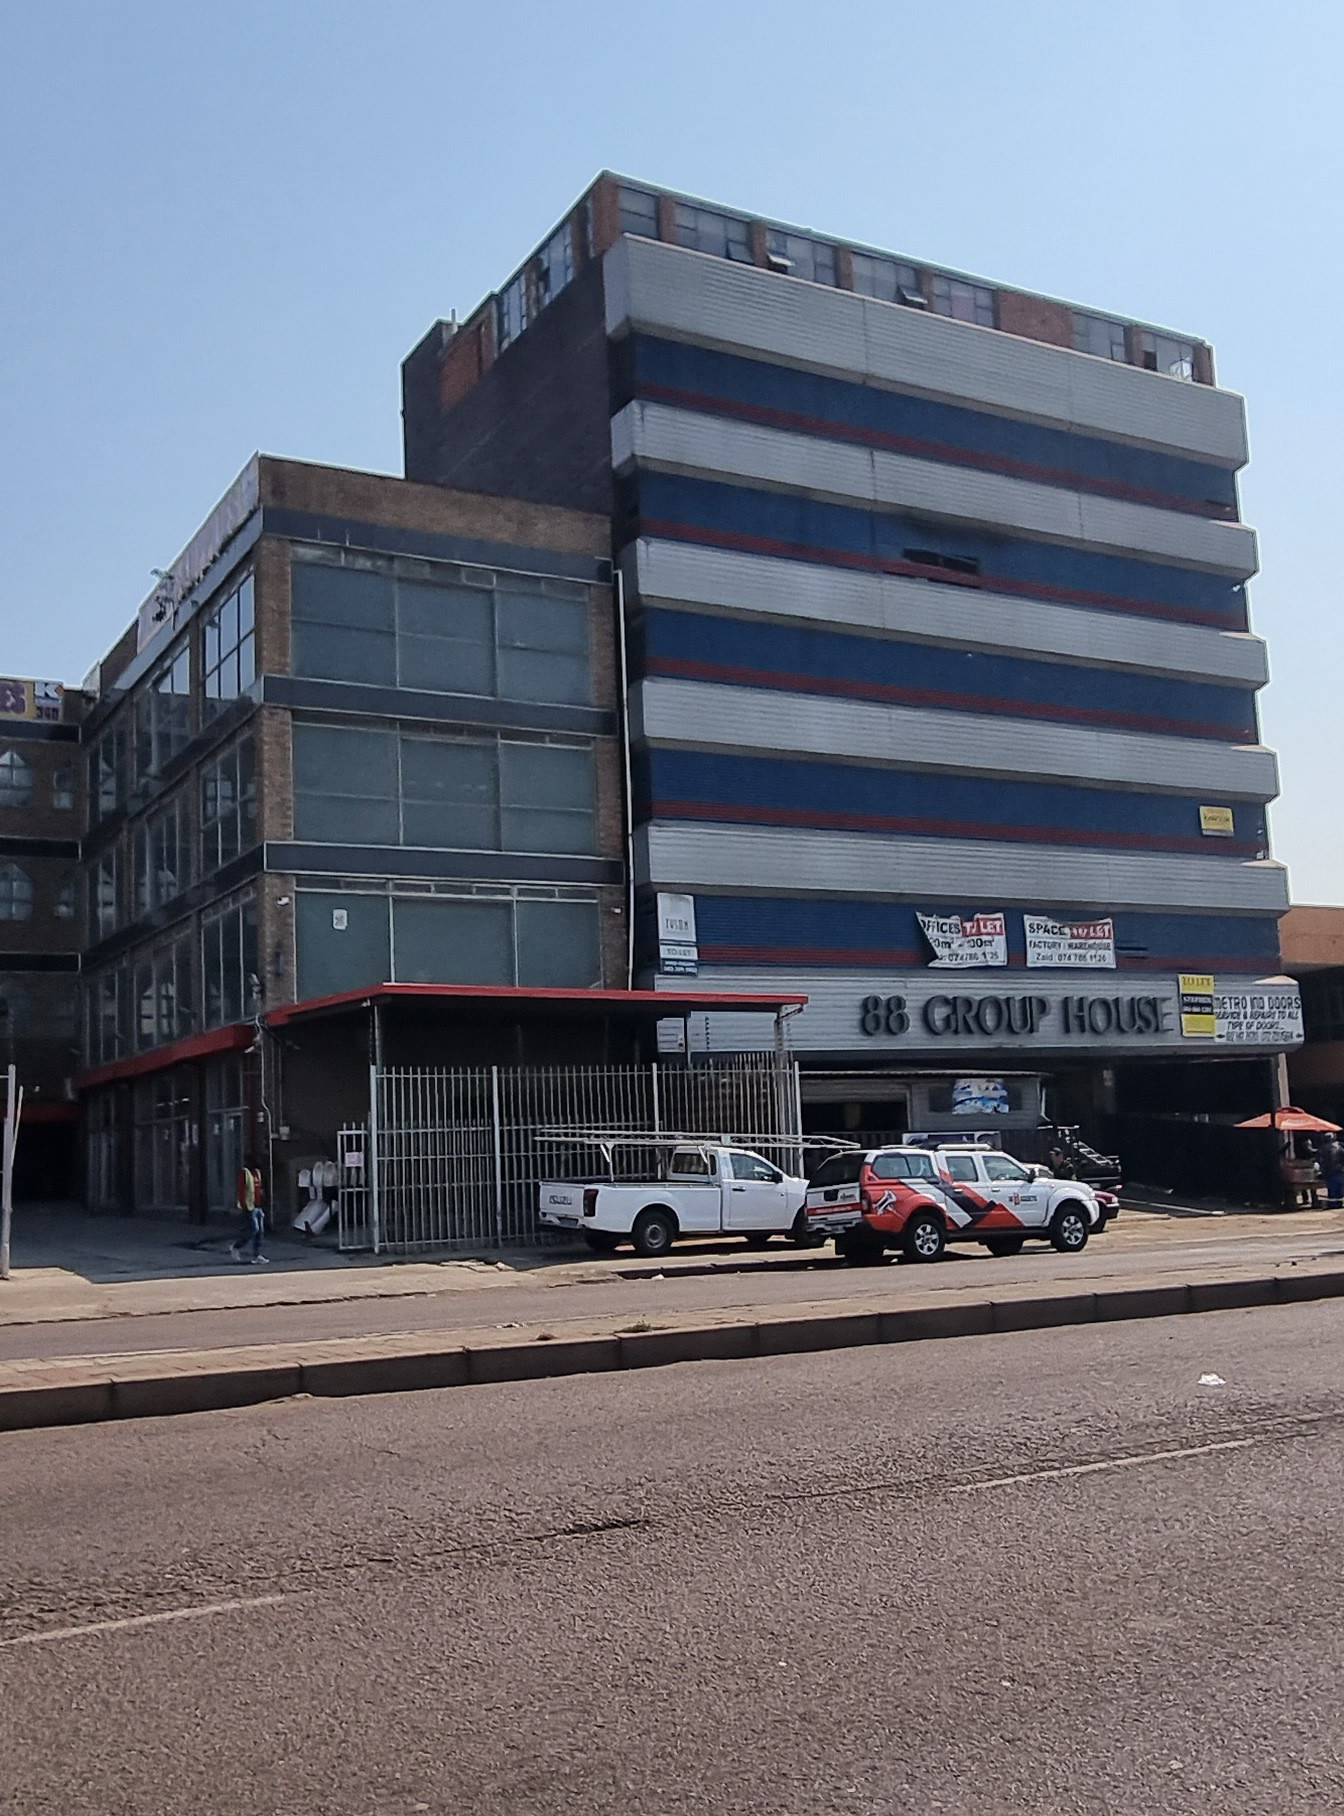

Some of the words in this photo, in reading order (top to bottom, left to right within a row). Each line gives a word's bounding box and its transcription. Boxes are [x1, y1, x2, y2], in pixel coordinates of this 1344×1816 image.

[980, 920, 1002, 932] LET
[1028, 922, 1067, 936] SPACE
[1089, 924, 1110, 938] LET
[1214, 996, 1248, 1010] METRO
[1268, 996, 1301, 1010] DOORS
[860, 995, 910, 1036] 88
[922, 995, 1052, 1036] GROUP
[1062, 996, 1174, 1034] HOUSE
[1227, 1021, 1244, 1030] TYPE
[1245, 1021, 1255, 1030] OF
[549, 1195, 573, 1205] ISUZU
